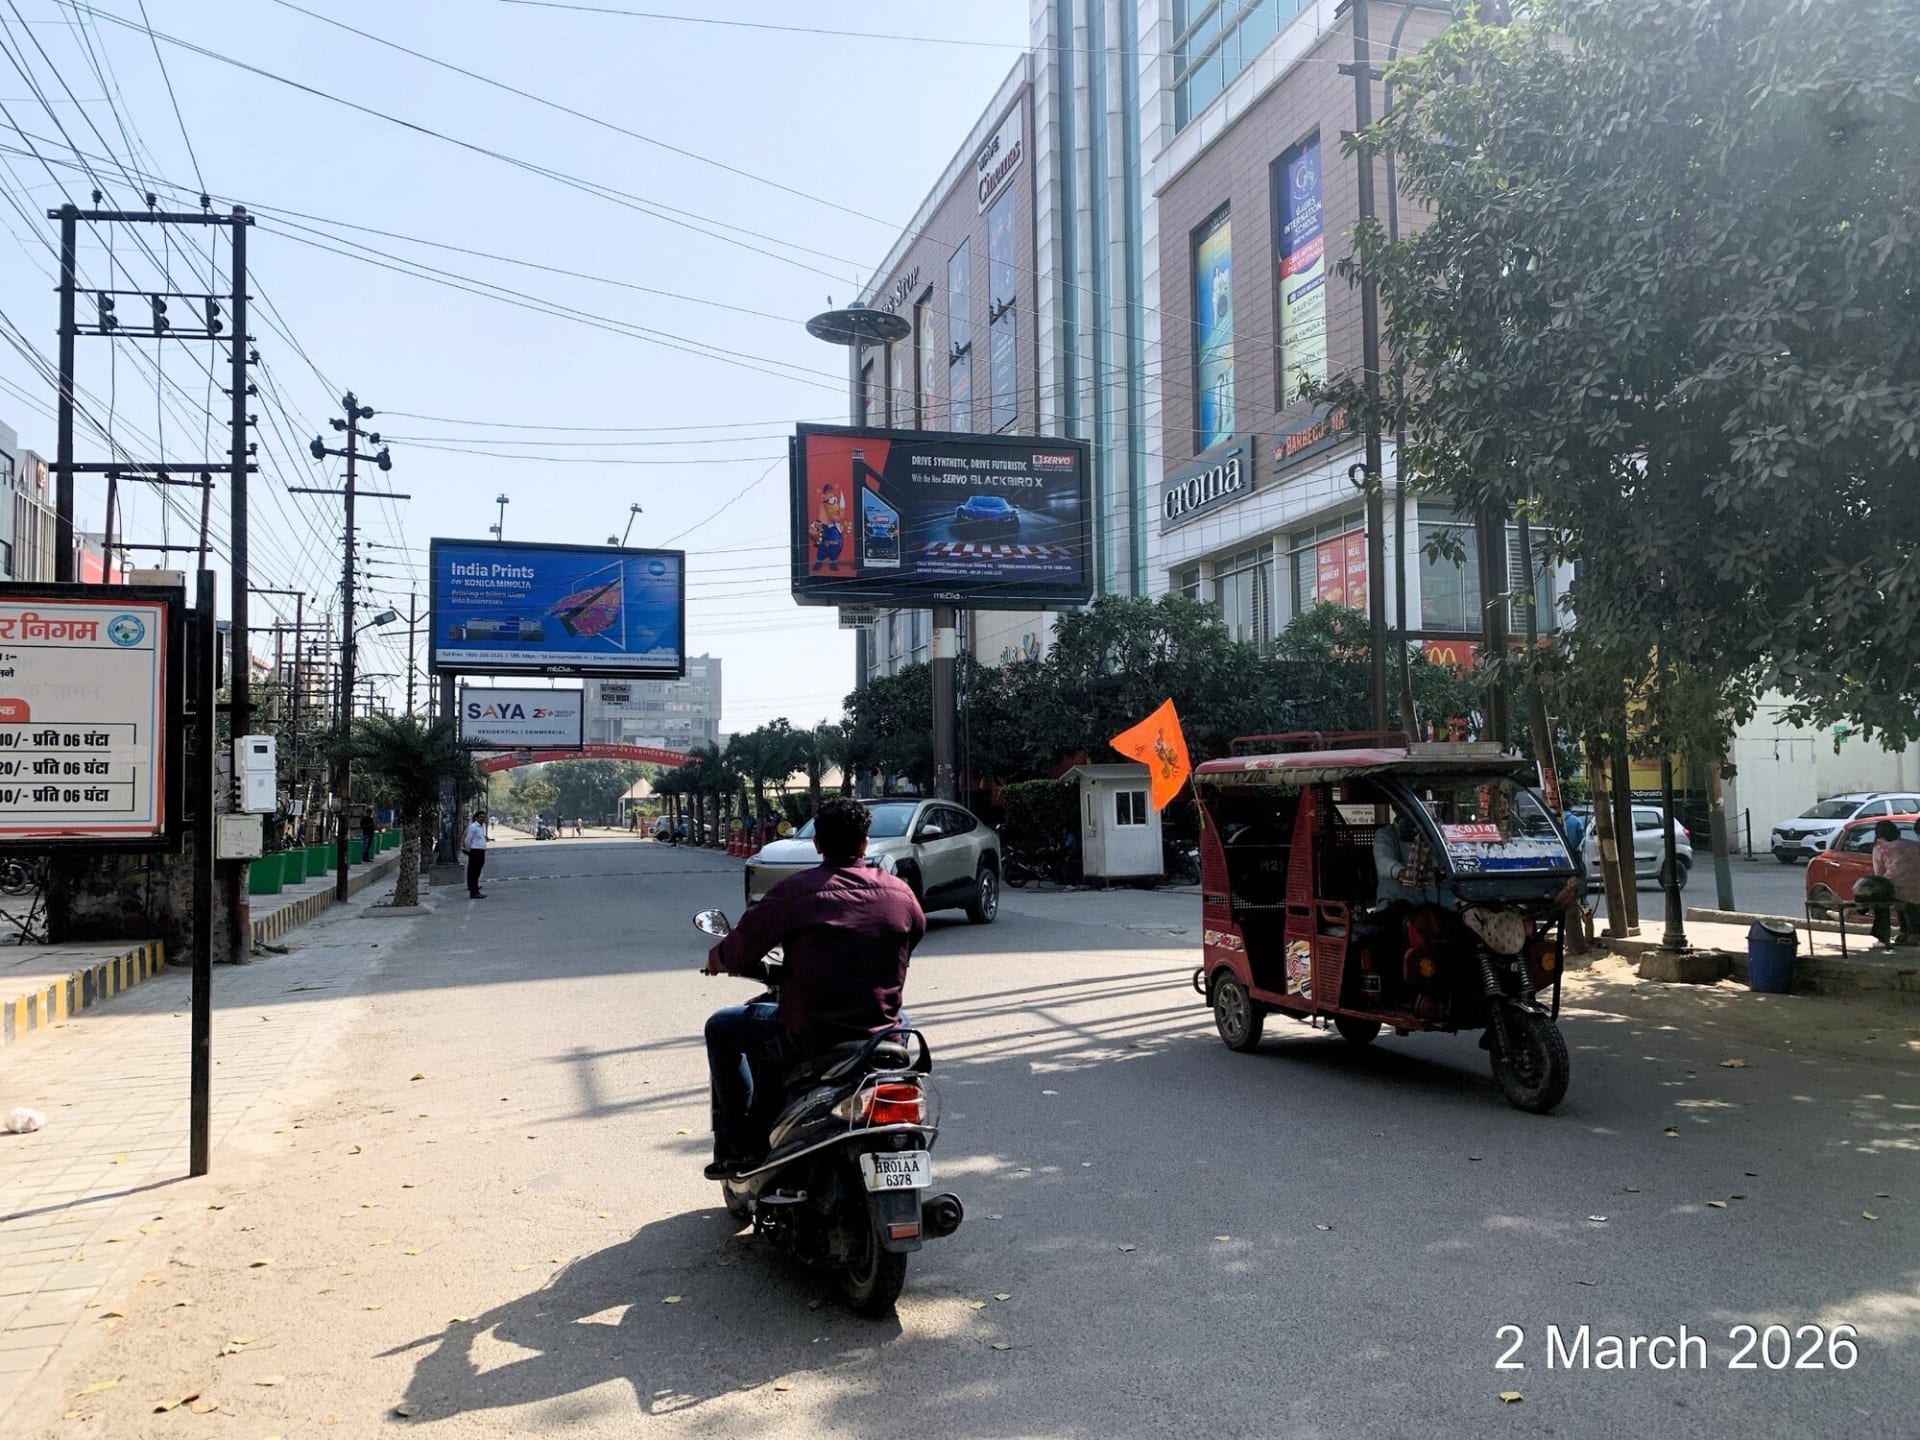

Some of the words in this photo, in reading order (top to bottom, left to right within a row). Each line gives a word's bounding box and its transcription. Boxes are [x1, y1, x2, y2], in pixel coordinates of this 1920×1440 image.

[979, 141, 1020, 204] Cinemas
[1284, 200, 1323, 234] INTERNATION
[912, 455, 932, 466] DRIVE
[933, 456, 969, 470] SYNTHETIC,
[970, 459, 990, 469] DRIVE
[991, 460, 1027, 471] FUTURISTIC
[1043, 456, 1071, 465] SERVO
[942, 473, 967, 485] SERVO
[970, 474, 1033, 487] BLACKBIRD
[1035, 478, 1043, 488] X
[452, 562, 488, 576] India
[492, 564, 535, 578] Prints
[465, 579, 495, 587] KONICA
[496, 580, 531, 589] MINOLTA
[20, 612, 99, 641] निगम
[467, 703, 526, 720] SAYA
[32, 730, 60, 747] प्रति
[63, 733, 81, 747] 06
[83, 730, 110, 747] घंटा
[634, 748, 665, 757] VEHICLE
[32, 758, 60, 775] प्रति
[63, 761, 81, 775] 06
[83, 758, 110, 775] घंटा
[32, 786, 60, 803] प्रति
[63, 789, 81, 803] 06
[83, 785, 110, 803] घंटा
[876, 1160, 920, 1174] HR01AA
[886, 1173, 912, 1187] 6378
